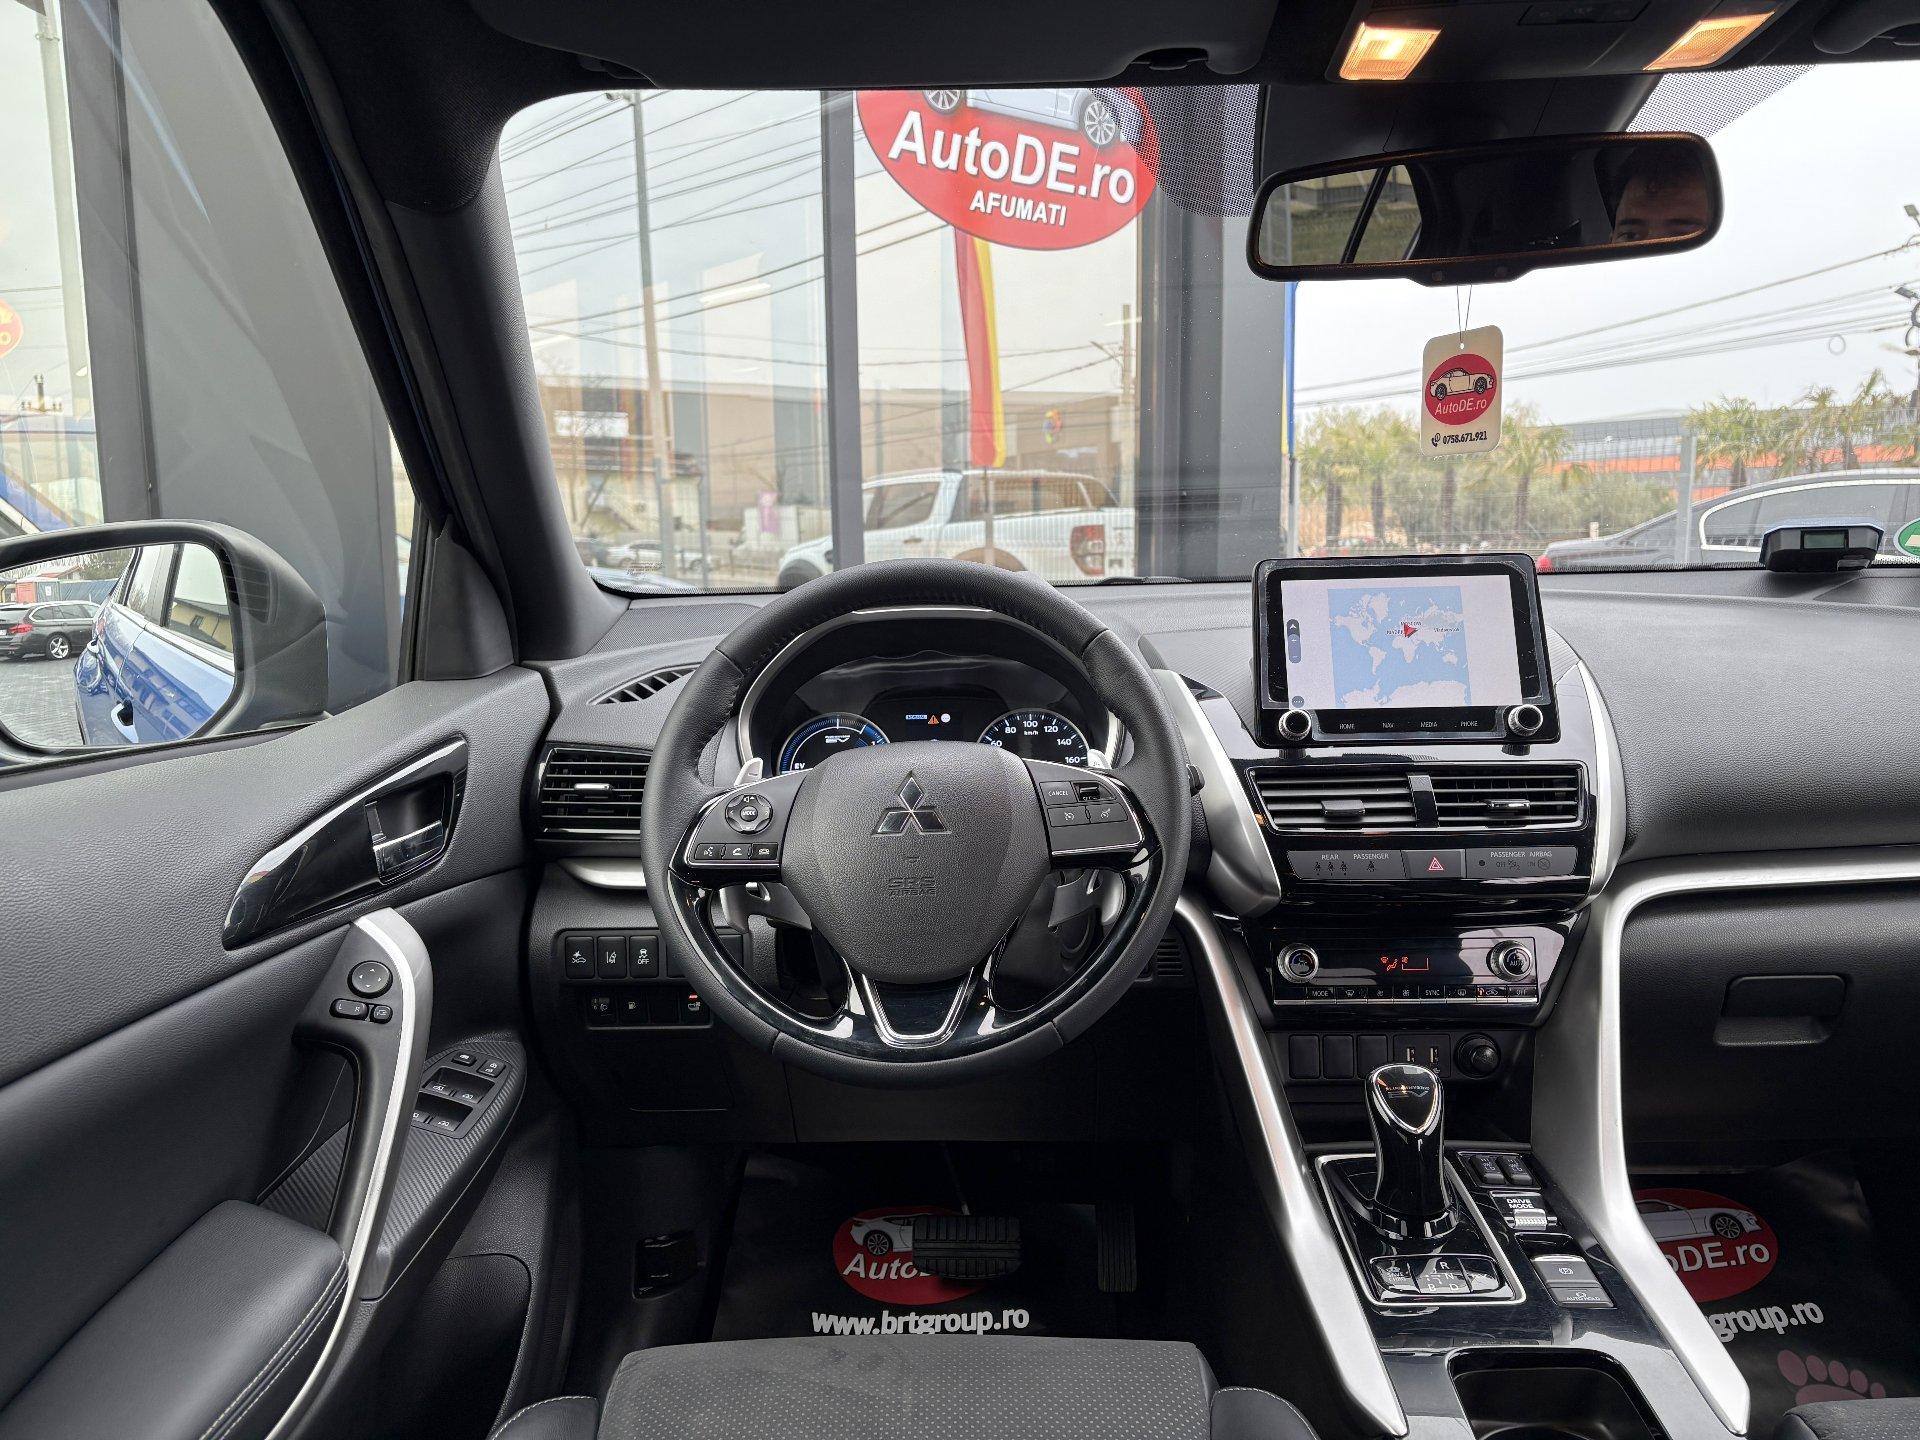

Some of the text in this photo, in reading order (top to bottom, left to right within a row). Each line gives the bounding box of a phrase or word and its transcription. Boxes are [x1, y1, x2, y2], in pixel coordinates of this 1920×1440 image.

[887, 109, 1136, 206] AutoDE.ro
[969, 190, 1067, 227] AFUMATI
[1434, 397, 1487, 416] AutoDE.ro
[1442, 430, 1488, 445] 0758.671.921
[1022, 720, 1038, 728] 100
[1004, 726, 1017, 734] 80
[1043, 725, 1059, 733] 120
[1056, 738, 1072, 746] 140
[1064, 756, 1081, 764] 160
[1529, 850, 1553, 858] AIRBAG
[1439, 1261, 1450, 1270] R
[1444, 1272, 1455, 1280] N
[1428, 1284, 1437, 1292] B
[1449, 1283, 1460, 1291] D
[811, 1309, 1030, 1335] www.brtgroup.ro
